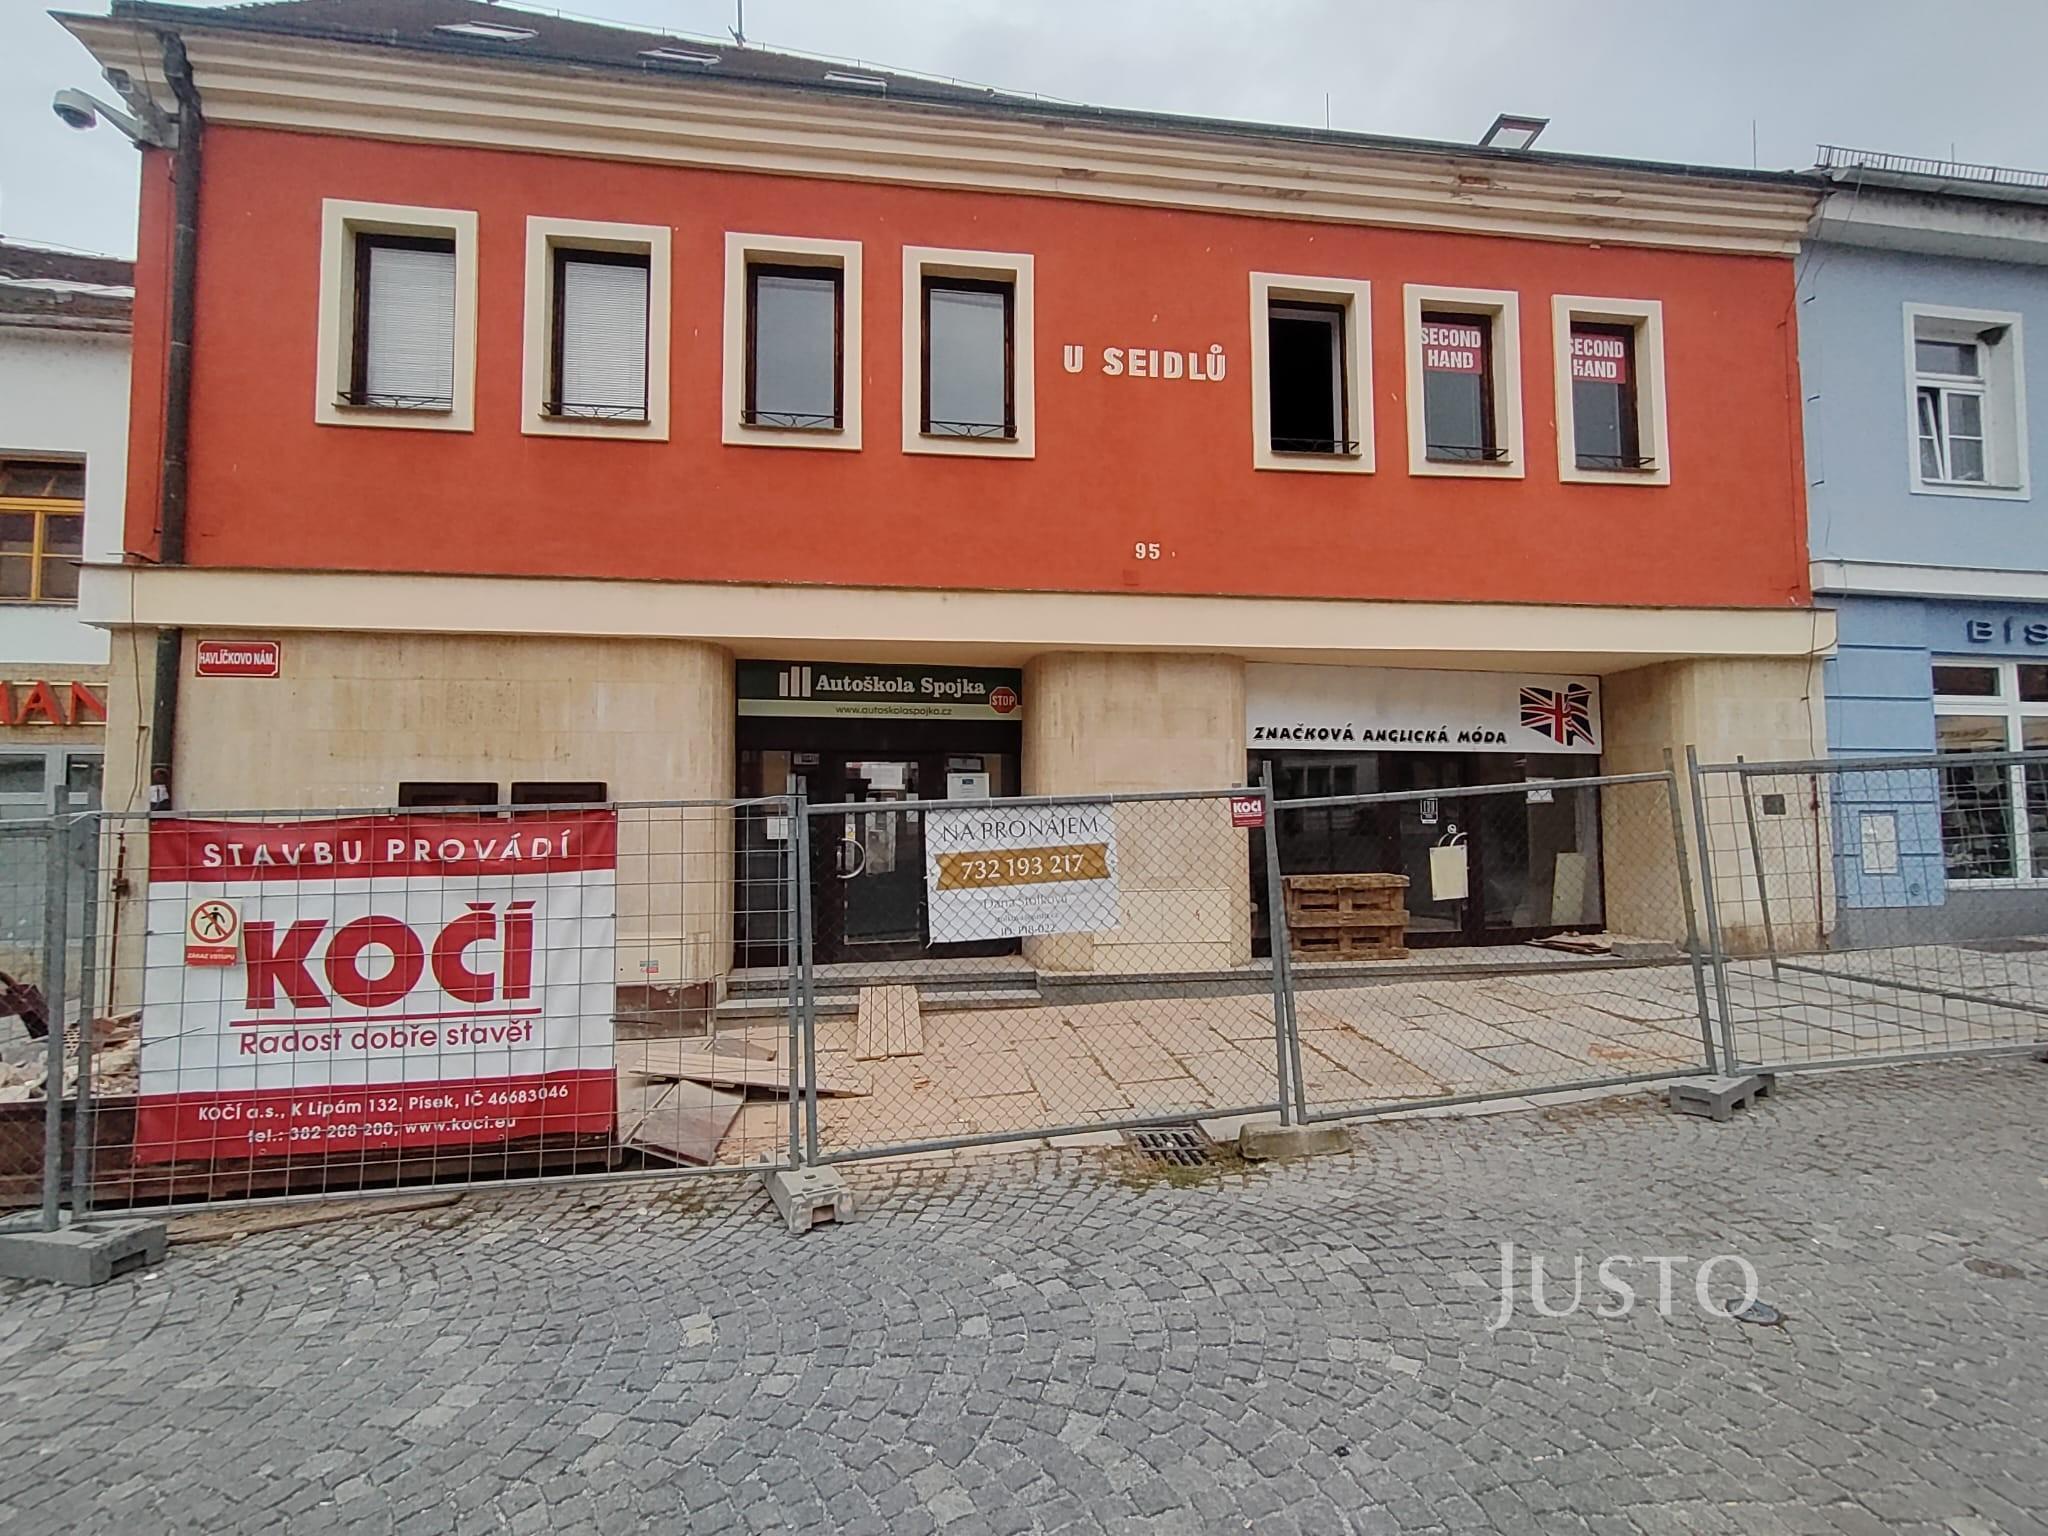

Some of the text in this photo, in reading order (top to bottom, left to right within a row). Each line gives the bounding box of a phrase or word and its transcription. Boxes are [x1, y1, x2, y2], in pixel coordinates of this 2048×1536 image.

[1421, 327, 1481, 348] SECOND
[1063, 343, 1226, 382] U SEIDLŮ
[1427, 350, 1474, 369] HAND
[1572, 359, 1617, 379] HAND
[1135, 542, 1160, 560] 95
[199, 649, 276, 665] HAVLÍČKOVO NÁM.
[815, 674, 986, 699] Autoškola Spojka
[835, 704, 953, 717] www.autoskolaspojka.cz
[992, 694, 1015, 706] STOP
[1253, 723, 1508, 744] ZNAČKOVÁ ANGLICKÁ MÓDA
[942, 824, 975, 843] NA
[202, 828, 571, 867] STAVBU PROVÁDÍ
[960, 854, 1085, 881] 732 193 217
[243, 900, 537, 1010] KOČÍ
[240, 1019, 533, 1056] Radost dobře stavět
[199, 1084, 569, 1121] KOČÍ a.s., K Lipám 132, Písek, IČ 46683046
[289, 1125, 321, 1141] 382
[405, 1115, 516, 1135] www.koci.eu
